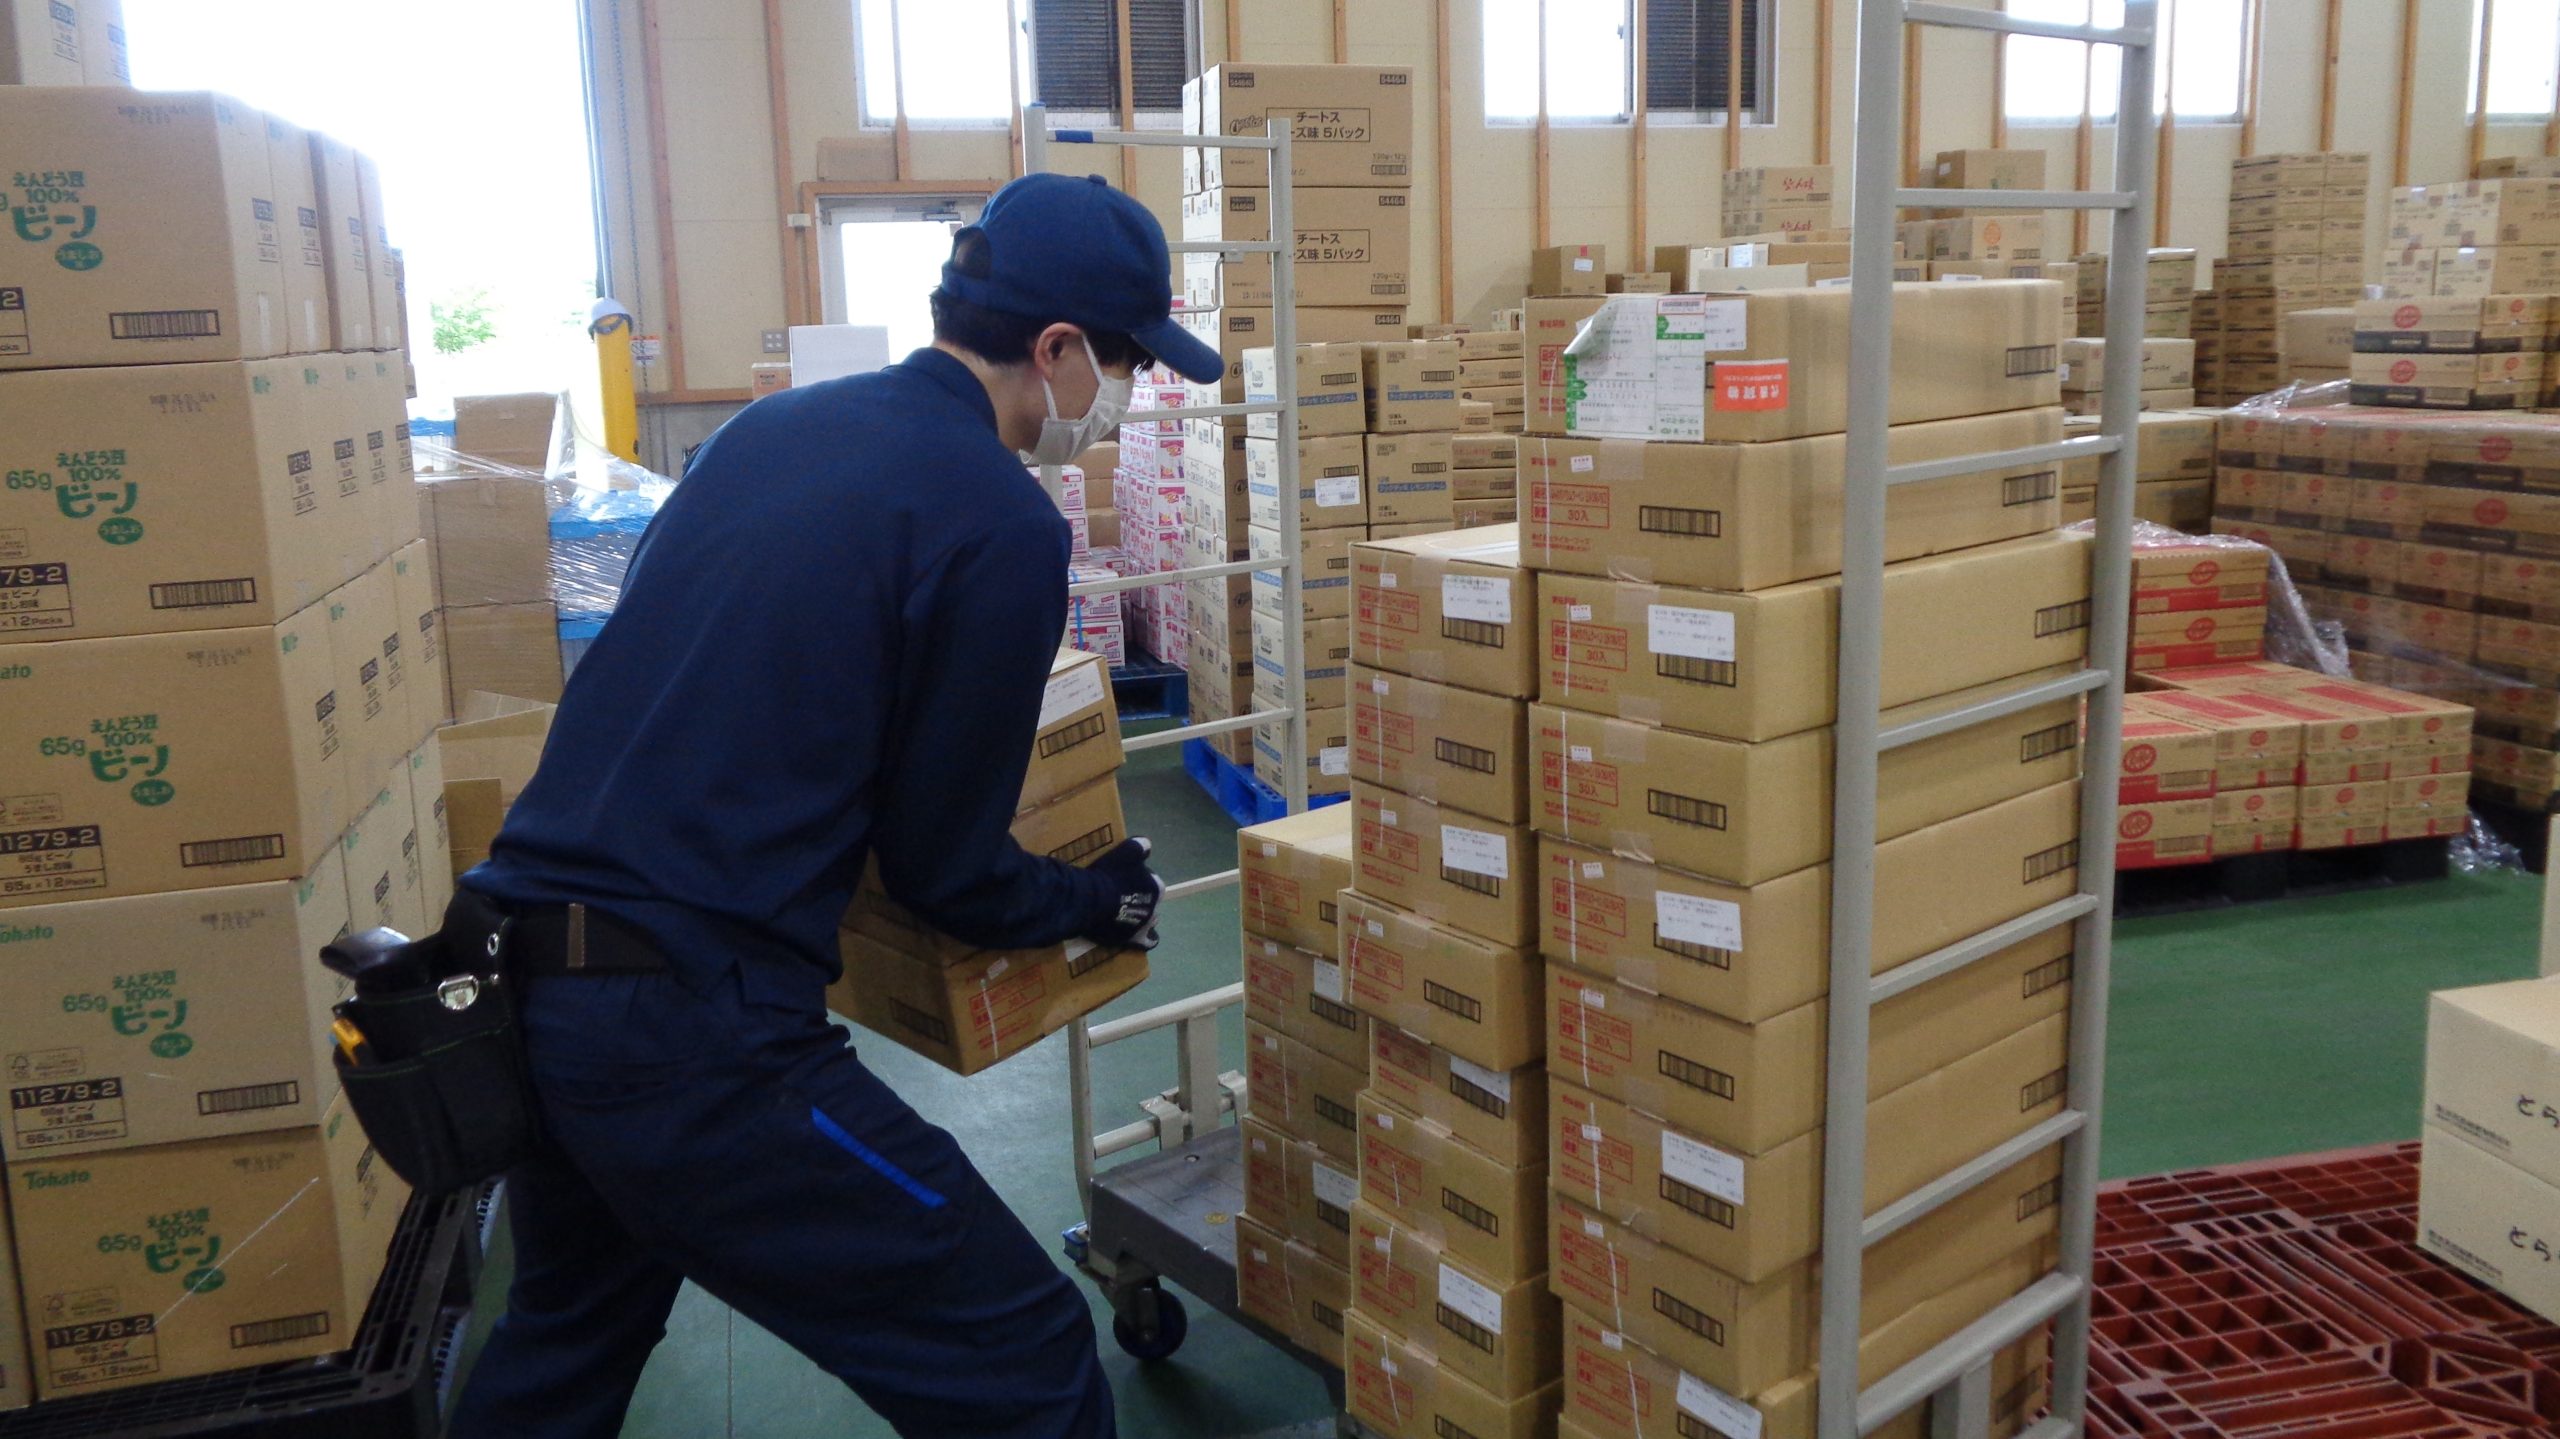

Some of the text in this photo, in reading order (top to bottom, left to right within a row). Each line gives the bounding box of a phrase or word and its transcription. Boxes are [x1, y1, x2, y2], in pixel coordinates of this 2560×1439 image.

[1296, 111, 1341, 122] チートス
[13, 171, 84, 187] えんどう豆
[26, 188, 79, 204] 100%
[12, 205, 97, 242] ビーノ
[1297, 233, 1340, 244] チートス
[56, 449, 127, 467] えんどう豆
[6, 470, 52, 490] 65g
[69, 467, 121, 482] 100%
[55, 482, 138, 518] ビーノ
[1568, 509, 1589, 521] 30入
[1586, 649, 1607, 663] 30入
[91, 714, 158, 734] えんどう豆
[40, 737, 86, 757] 65g
[102, 732, 153, 748] 100%
[89, 745, 169, 782] ビーノ
[1579, 783, 1600, 797] 30入
[0, 924, 54, 943] ohato
[112, 970, 177, 989] えんどう豆
[62, 994, 108, 1012] 65g
[124, 986, 173, 1003] 100%
[111, 999, 187, 1036] ビーノ
[15, 1081, 117, 1106] 11279-2
[147, 1208, 210, 1229] えんどう豆
[145, 1236, 221, 1274] ビーノ
[51, 1318, 150, 1346] 11279-2
